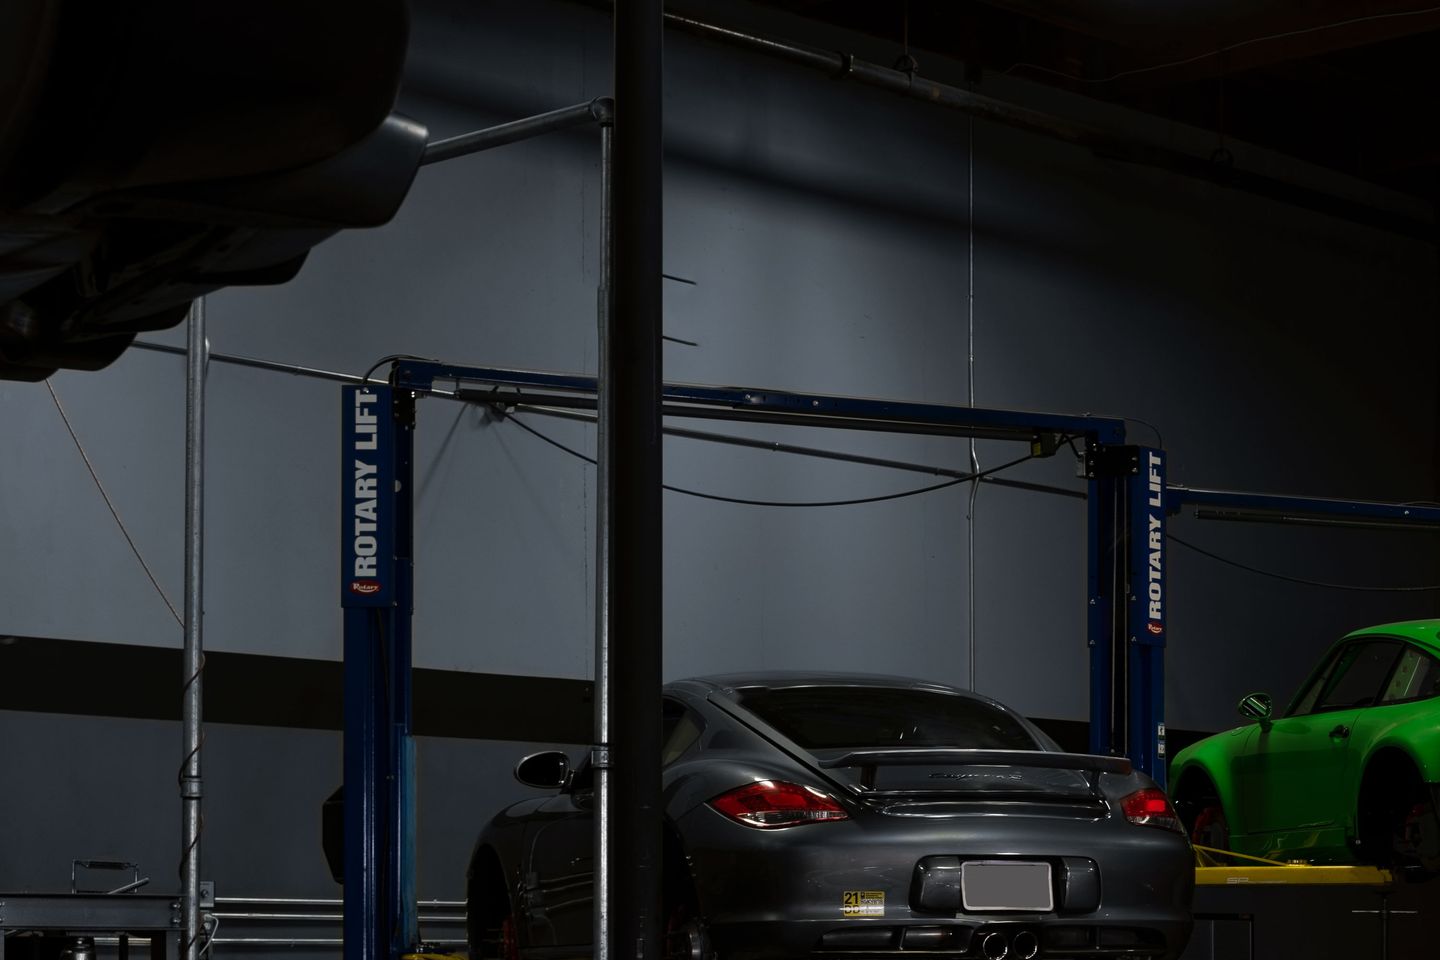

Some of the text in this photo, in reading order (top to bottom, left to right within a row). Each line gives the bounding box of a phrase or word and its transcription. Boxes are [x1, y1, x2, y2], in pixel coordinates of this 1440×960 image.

[354, 389, 377, 577] ROTARY LIFT
[1149, 451, 1162, 620] ROTARY LIFT
[844, 892, 859, 904] 21
